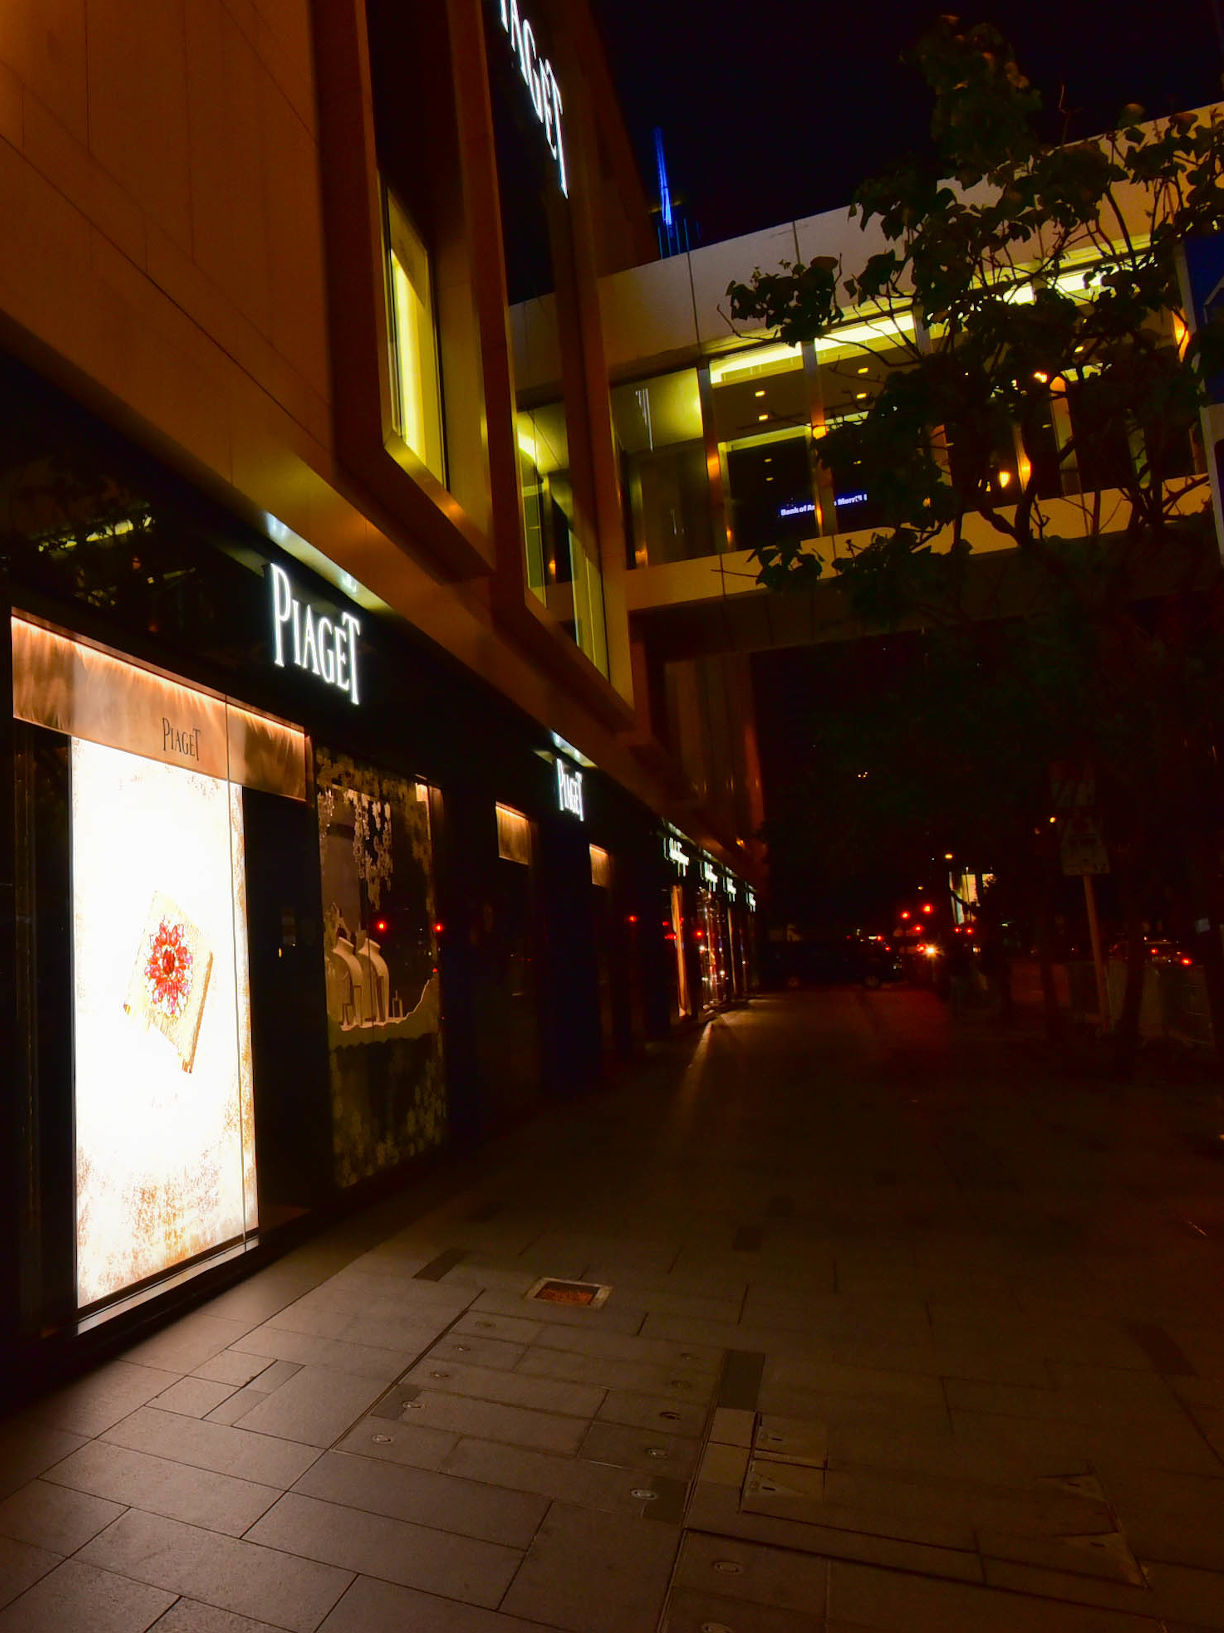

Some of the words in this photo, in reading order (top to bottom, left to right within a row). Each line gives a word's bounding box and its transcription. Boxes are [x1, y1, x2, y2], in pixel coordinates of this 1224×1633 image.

[500, 0, 568, 199] AGET
[270, 562, 361, 706] PIAGET
[162, 716, 201, 761] PIAGET
